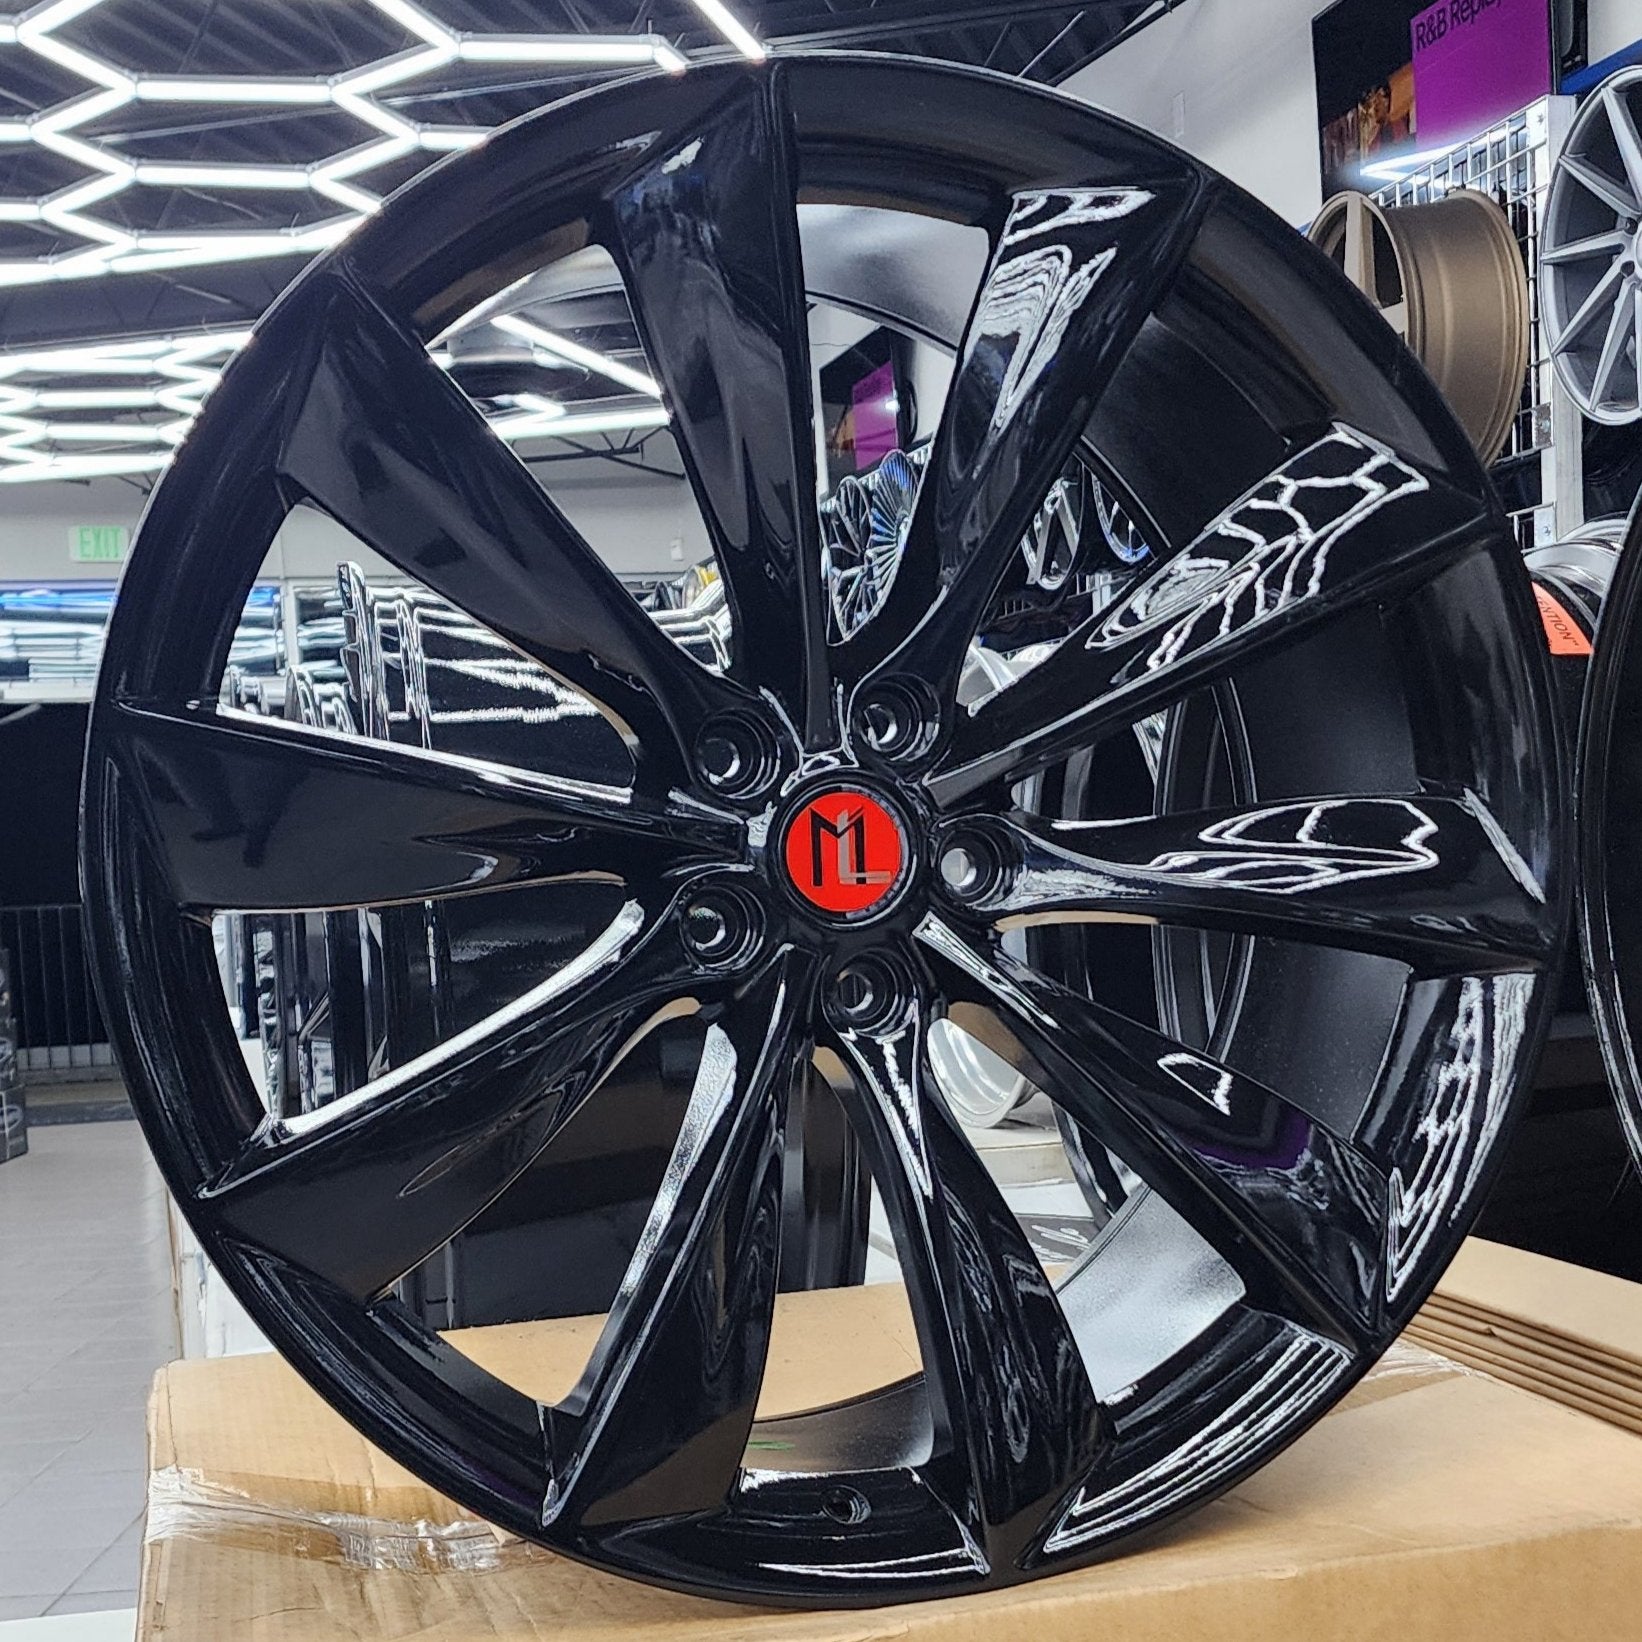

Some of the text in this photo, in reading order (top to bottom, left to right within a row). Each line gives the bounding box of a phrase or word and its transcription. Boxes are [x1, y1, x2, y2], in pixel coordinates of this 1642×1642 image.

[1416, 8, 1446, 52] R&B
[79, 527, 121, 558] EXIT
[809, 804, 893, 888] ML
